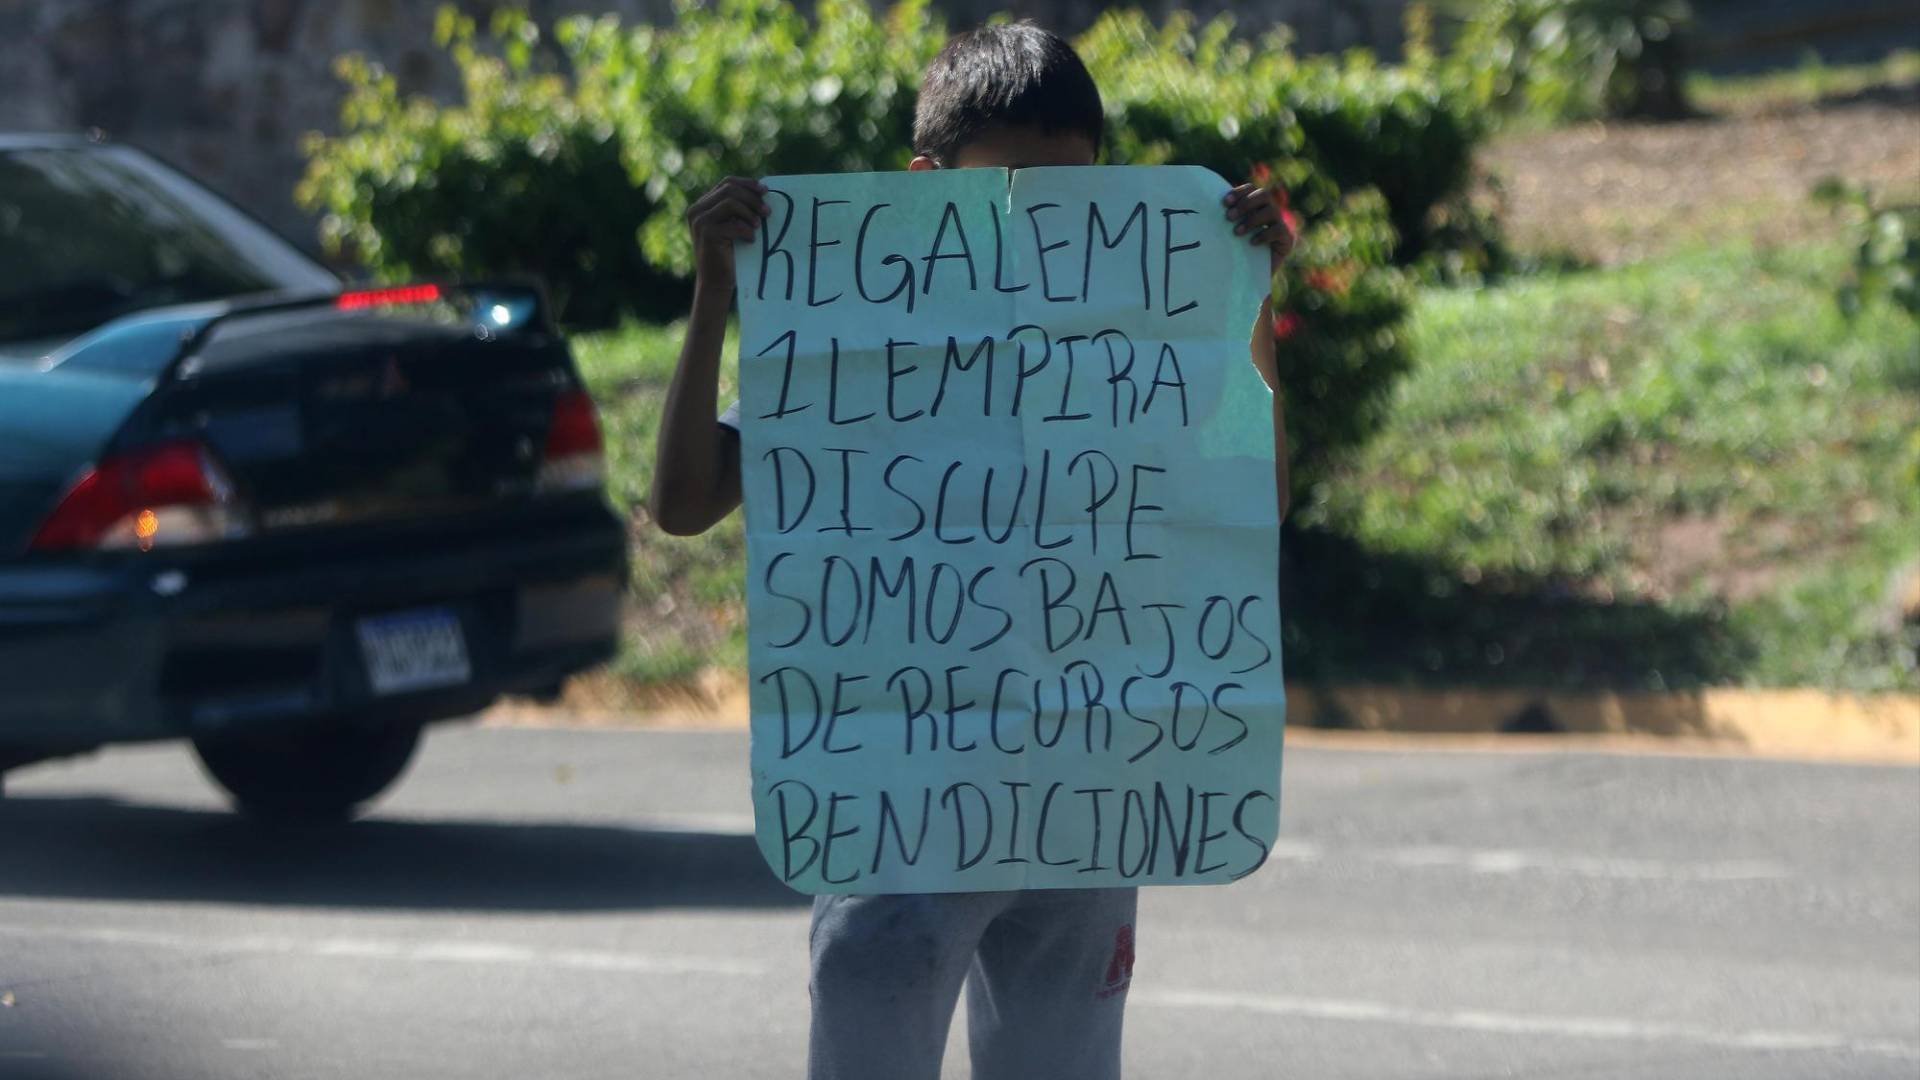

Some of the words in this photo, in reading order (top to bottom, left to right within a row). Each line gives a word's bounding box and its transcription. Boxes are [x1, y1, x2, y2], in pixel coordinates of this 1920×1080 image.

[757, 189, 1201, 317] REGALEME
[756, 330, 814, 420] 1
[827, 324, 1189, 428] LEMPIRA
[763, 446, 1167, 562] DISCULPE
[764, 552, 1013, 652] SOMOS
[1019, 557, 1272, 679] BAJOS
[760, 666, 870, 759] DE
[885, 660, 1249, 764] RECURSOS
[767, 779, 1276, 883] BENDICIONES
